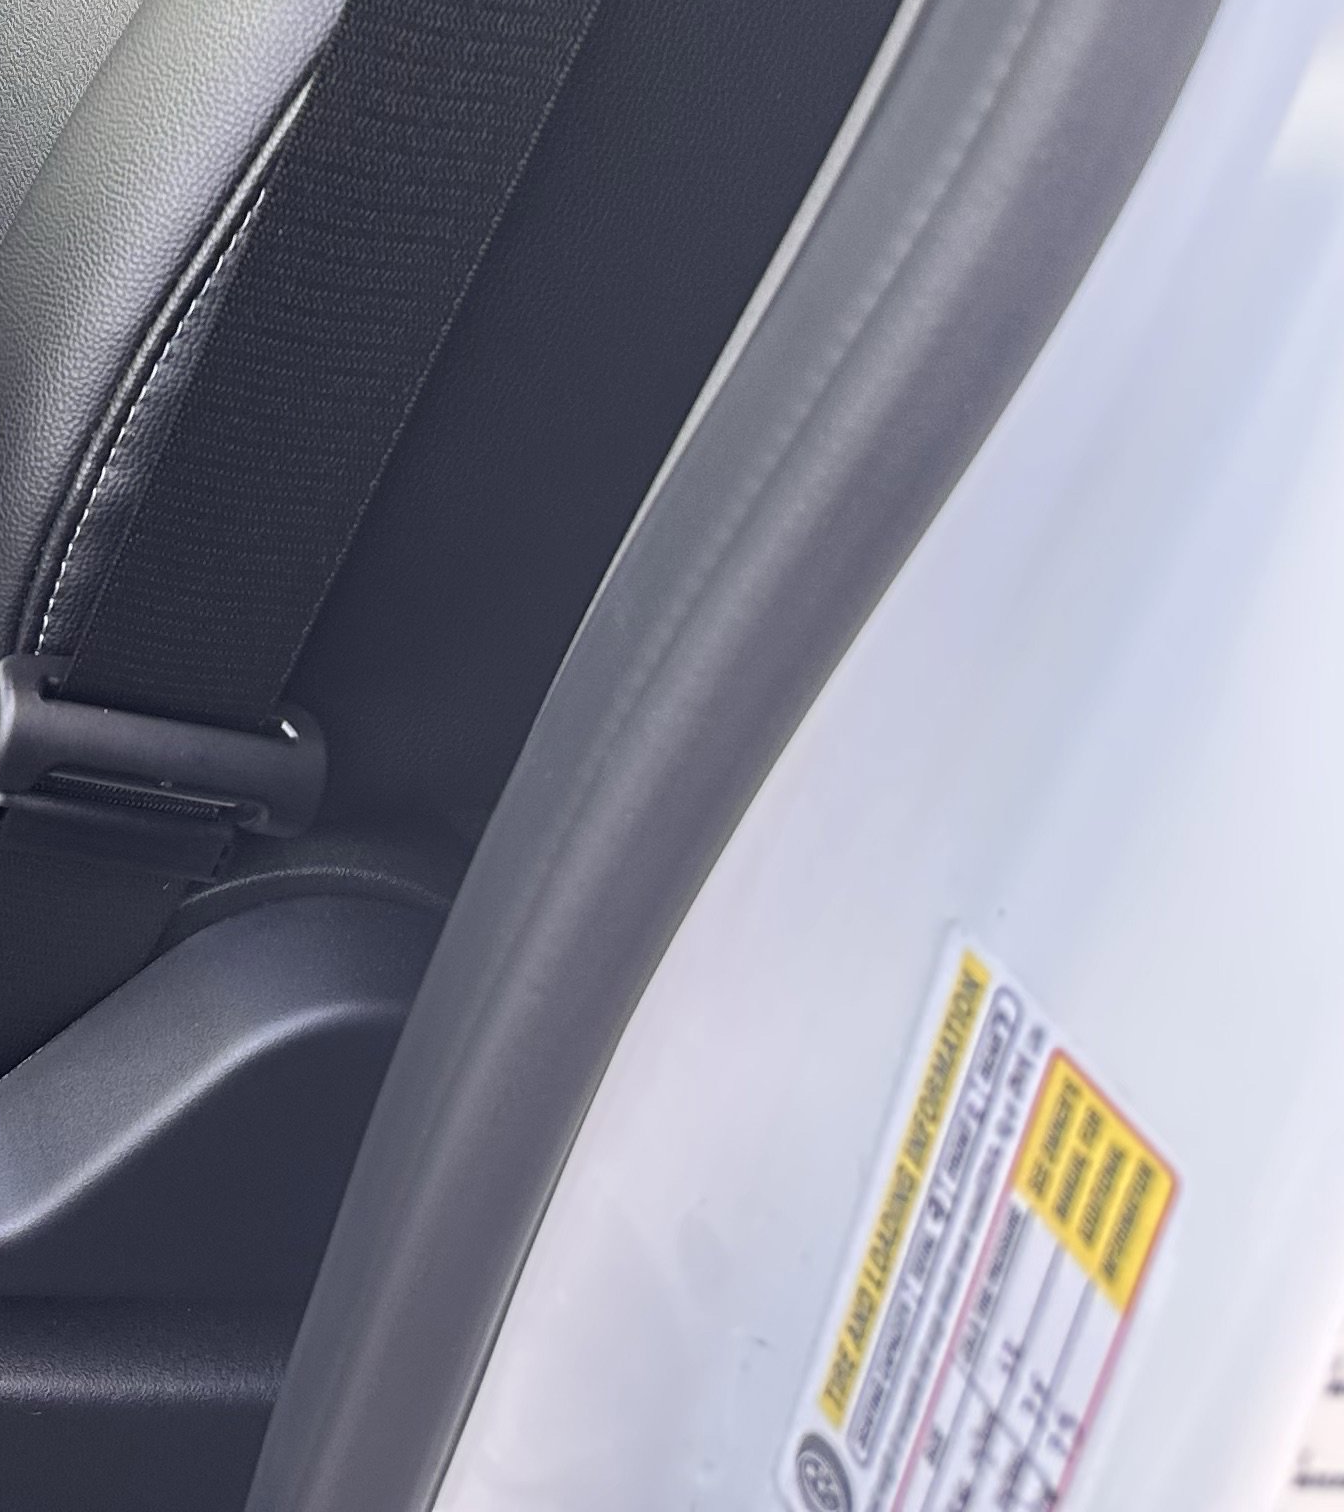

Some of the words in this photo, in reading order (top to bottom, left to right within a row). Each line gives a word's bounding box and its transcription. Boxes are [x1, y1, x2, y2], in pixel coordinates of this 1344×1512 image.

[827, 1348, 856, 1407] TIRE
[847, 1285, 876, 1344] AND
[866, 1164, 916, 1288] LOADING
[906, 968, 981, 1166] INFORMATION
